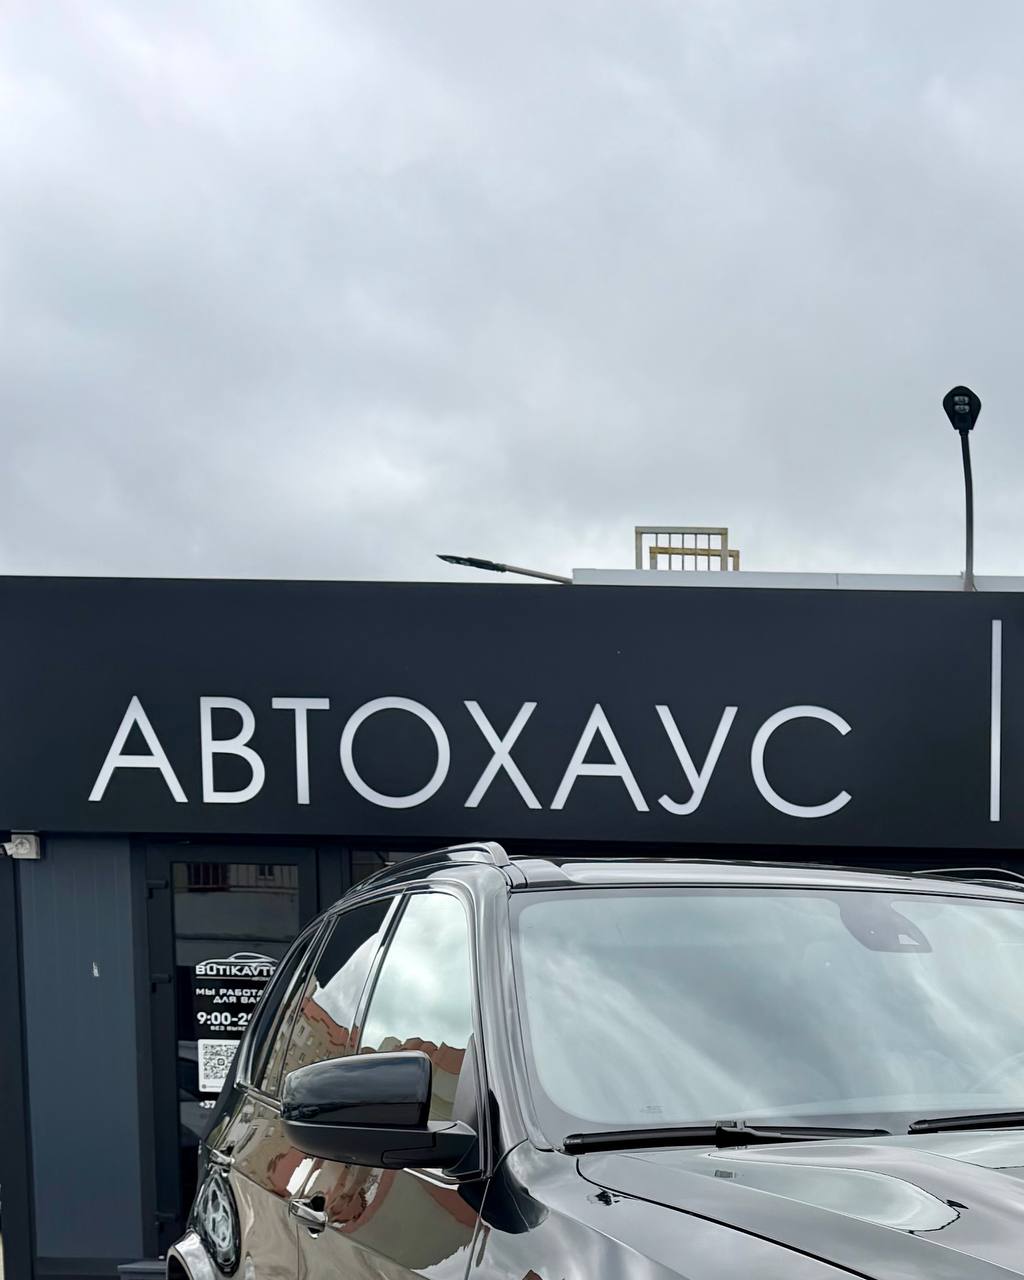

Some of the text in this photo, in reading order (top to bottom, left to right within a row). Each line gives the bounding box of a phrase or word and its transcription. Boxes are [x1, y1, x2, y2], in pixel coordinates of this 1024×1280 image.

[88, 695, 854, 818] АВТОХАУС
[196, 988, 264, 997] МЫ РАБОТА
[213, 996, 236, 1004] ДЛЯ
